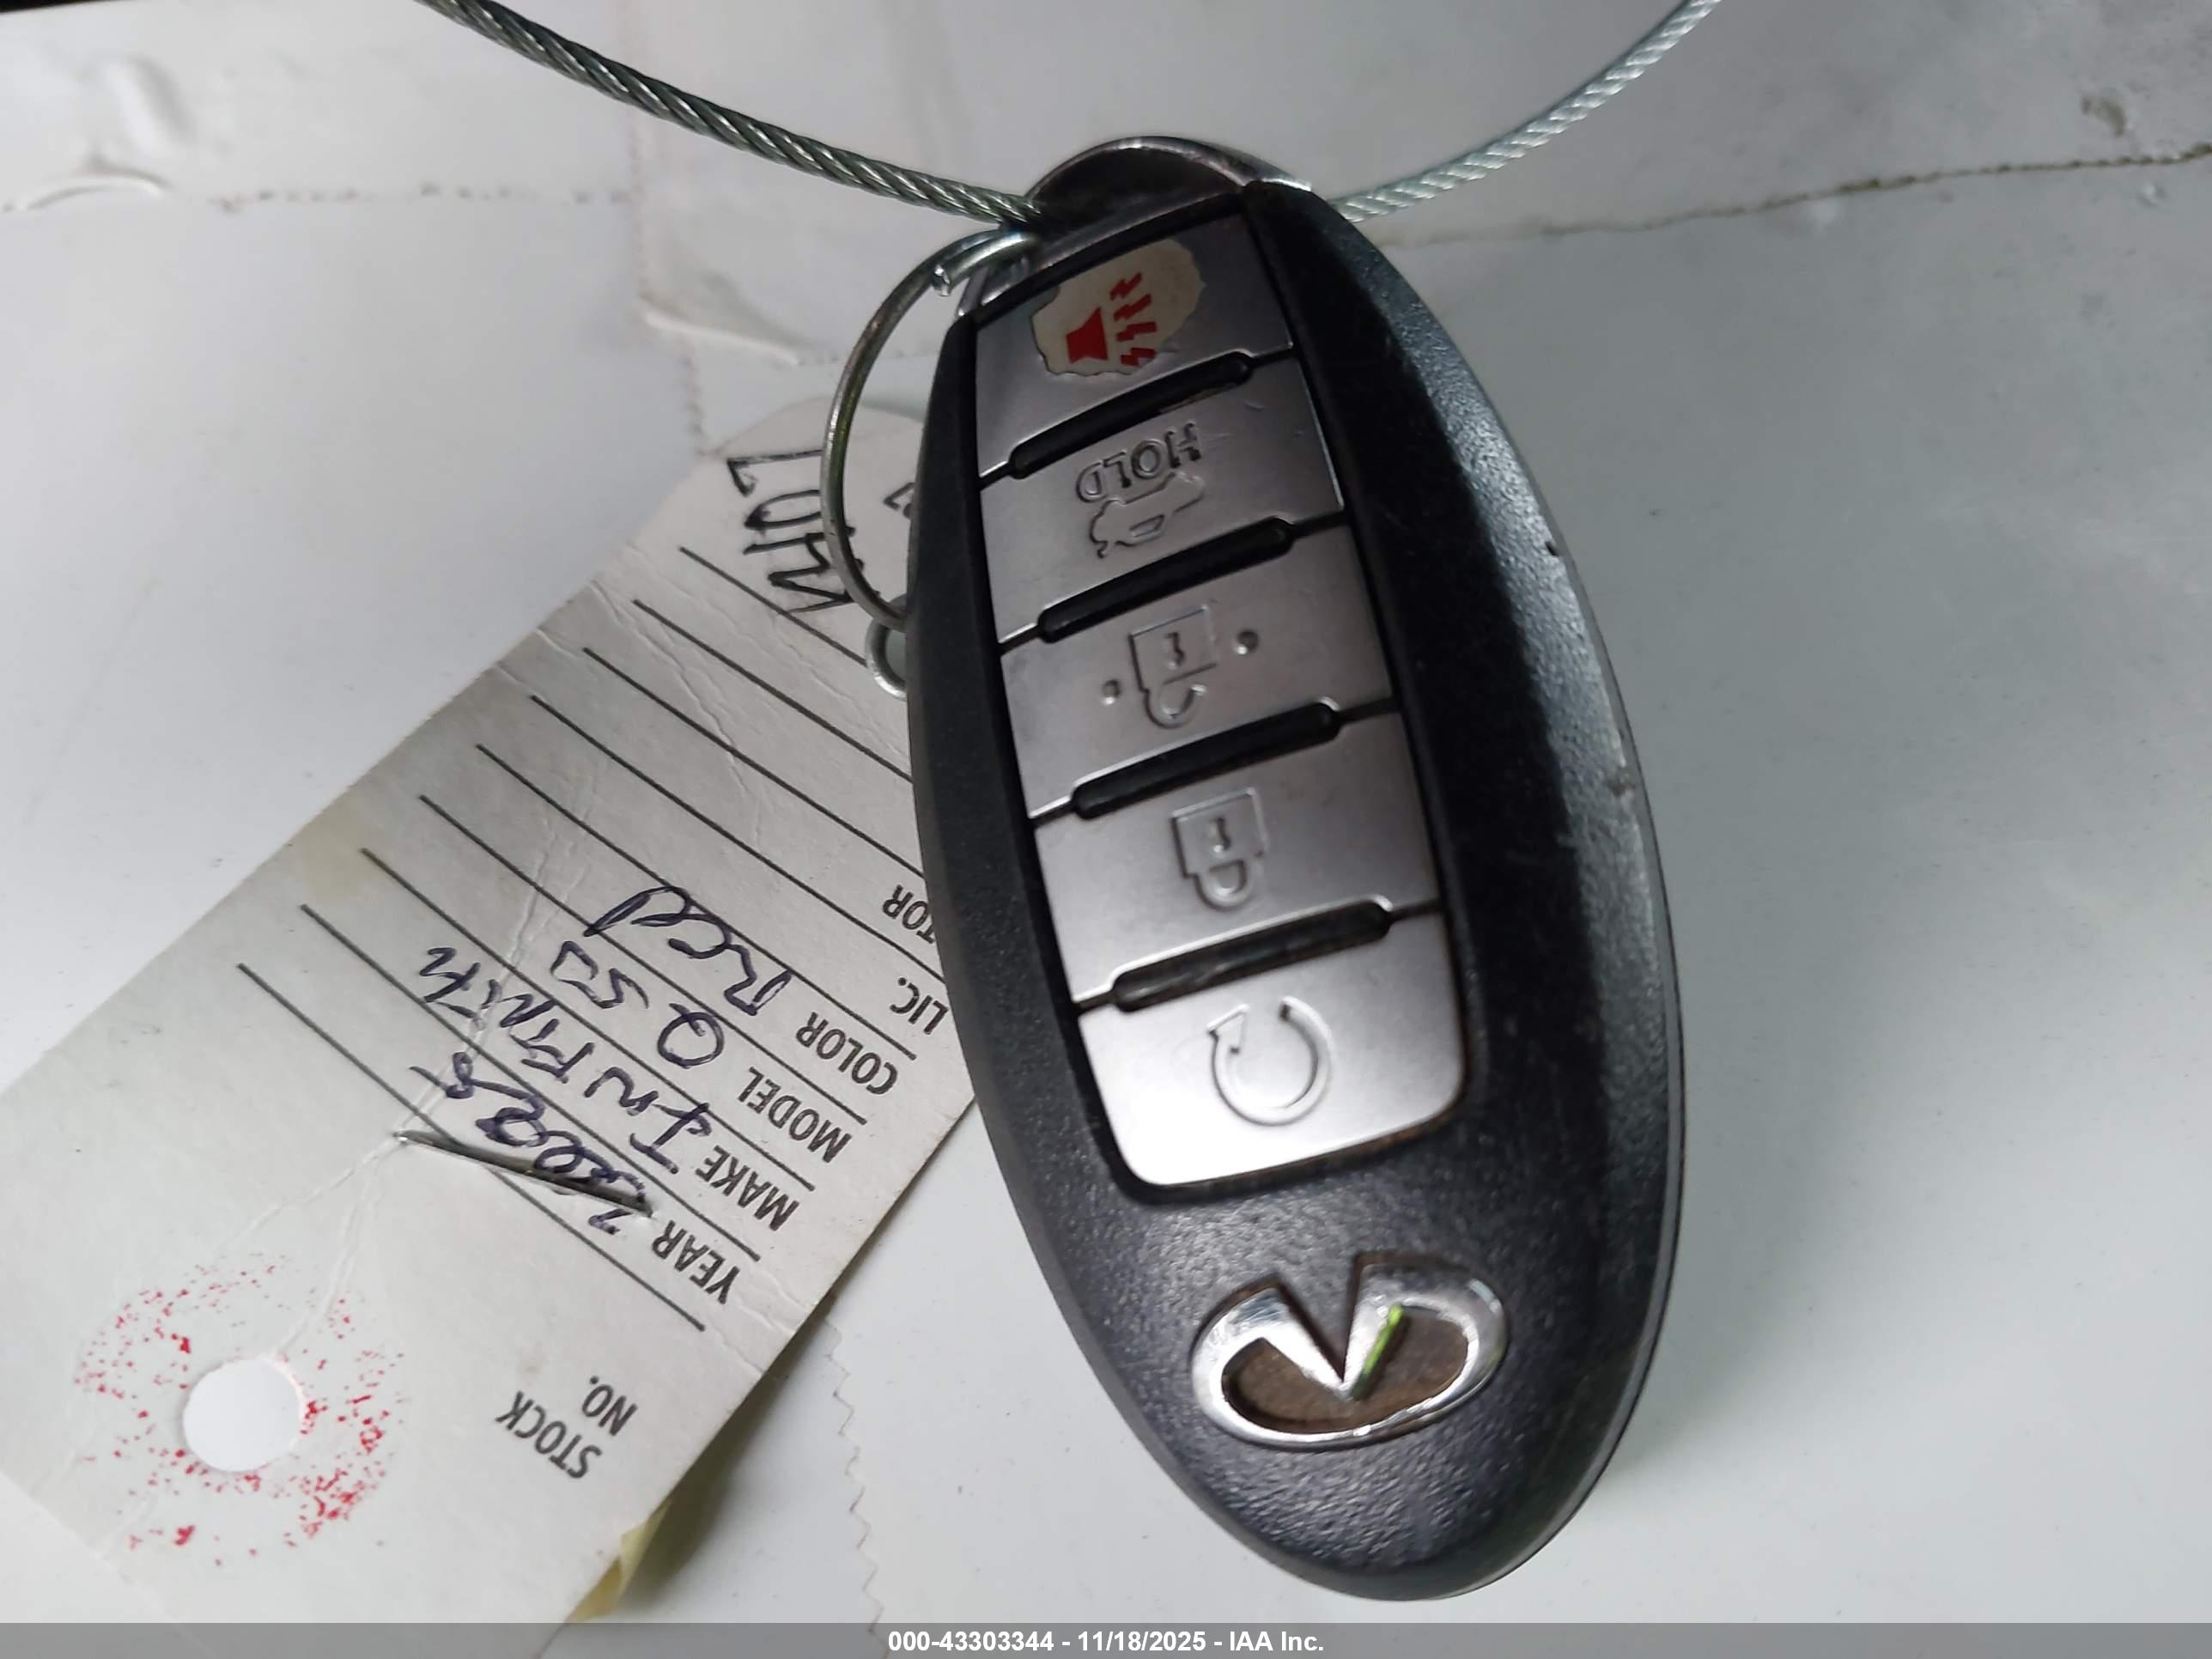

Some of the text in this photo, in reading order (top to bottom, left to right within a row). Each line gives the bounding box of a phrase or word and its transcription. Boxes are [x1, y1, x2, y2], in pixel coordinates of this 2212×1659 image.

[1075, 421, 1203, 503] HOLD
[883, 884, 935, 944] TOR
[890, 976, 949, 1035] LIC.
[795, 1012, 898, 1095] COLOR
[738, 1066, 853, 1163] MODEL
[694, 1145, 800, 1231] MAKE
[651, 1219, 741, 1305] YEAR
[495, 1390, 603, 1479] STOCK
[581, 1375, 638, 1437] NO.
